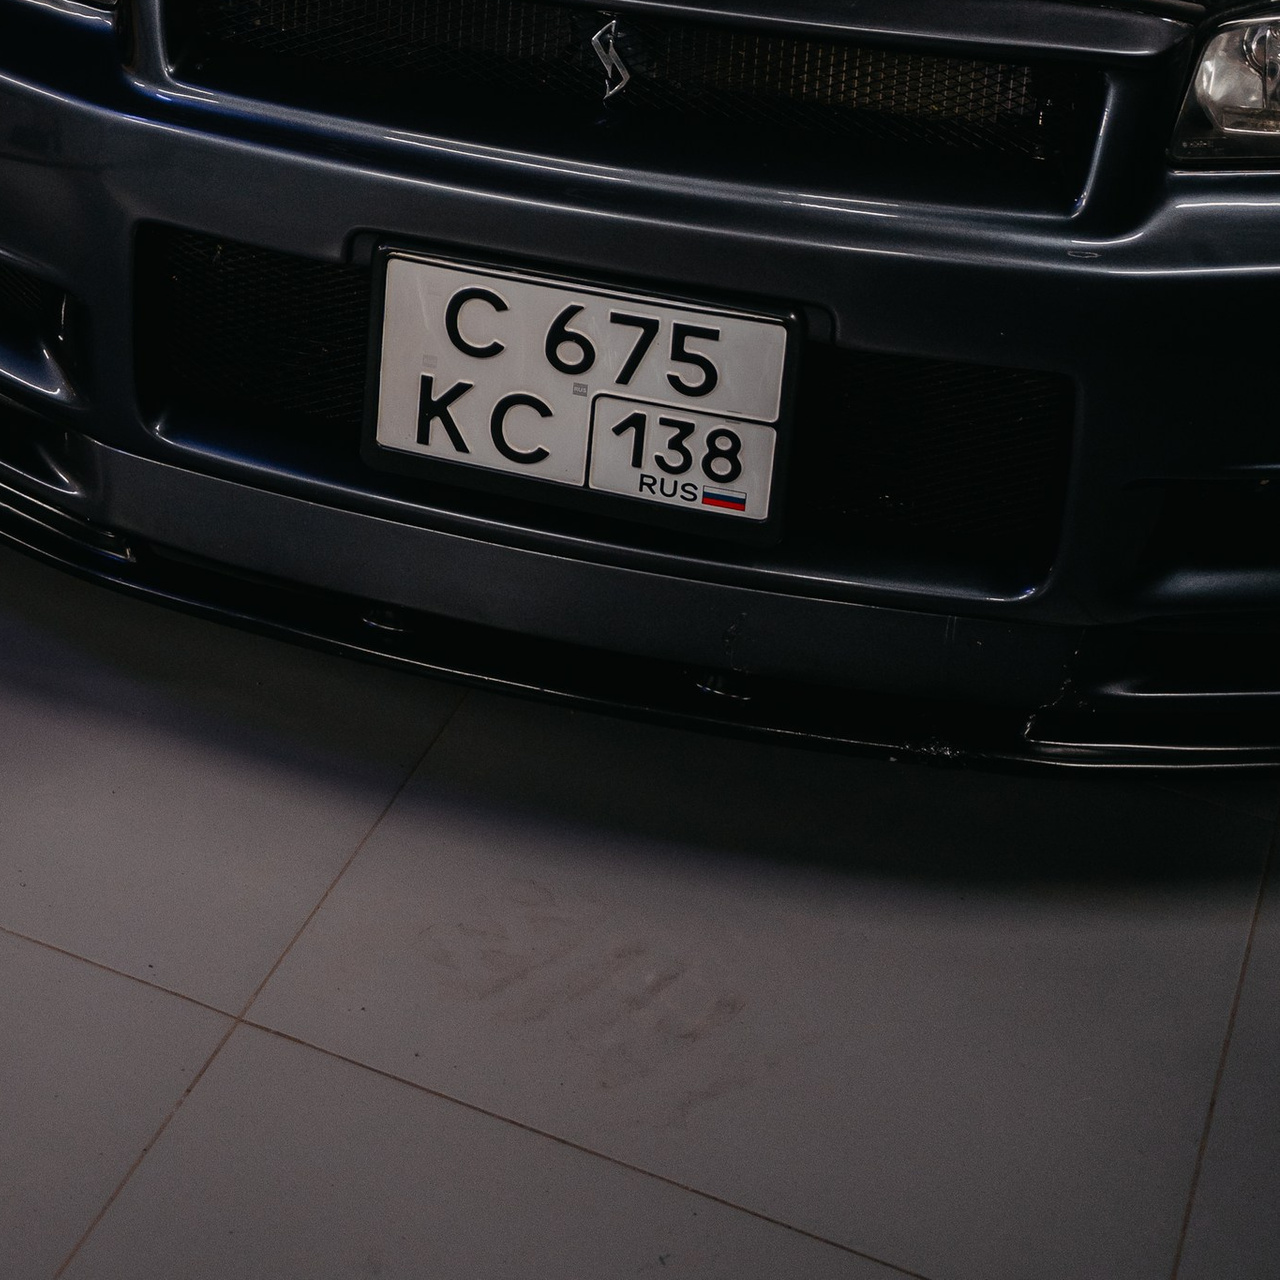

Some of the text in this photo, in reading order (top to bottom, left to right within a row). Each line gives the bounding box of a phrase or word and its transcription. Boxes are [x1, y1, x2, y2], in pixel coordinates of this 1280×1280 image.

[544, 304, 721, 397] 675
[612, 411, 742, 484] 138
[639, 473, 698, 502] RUS
